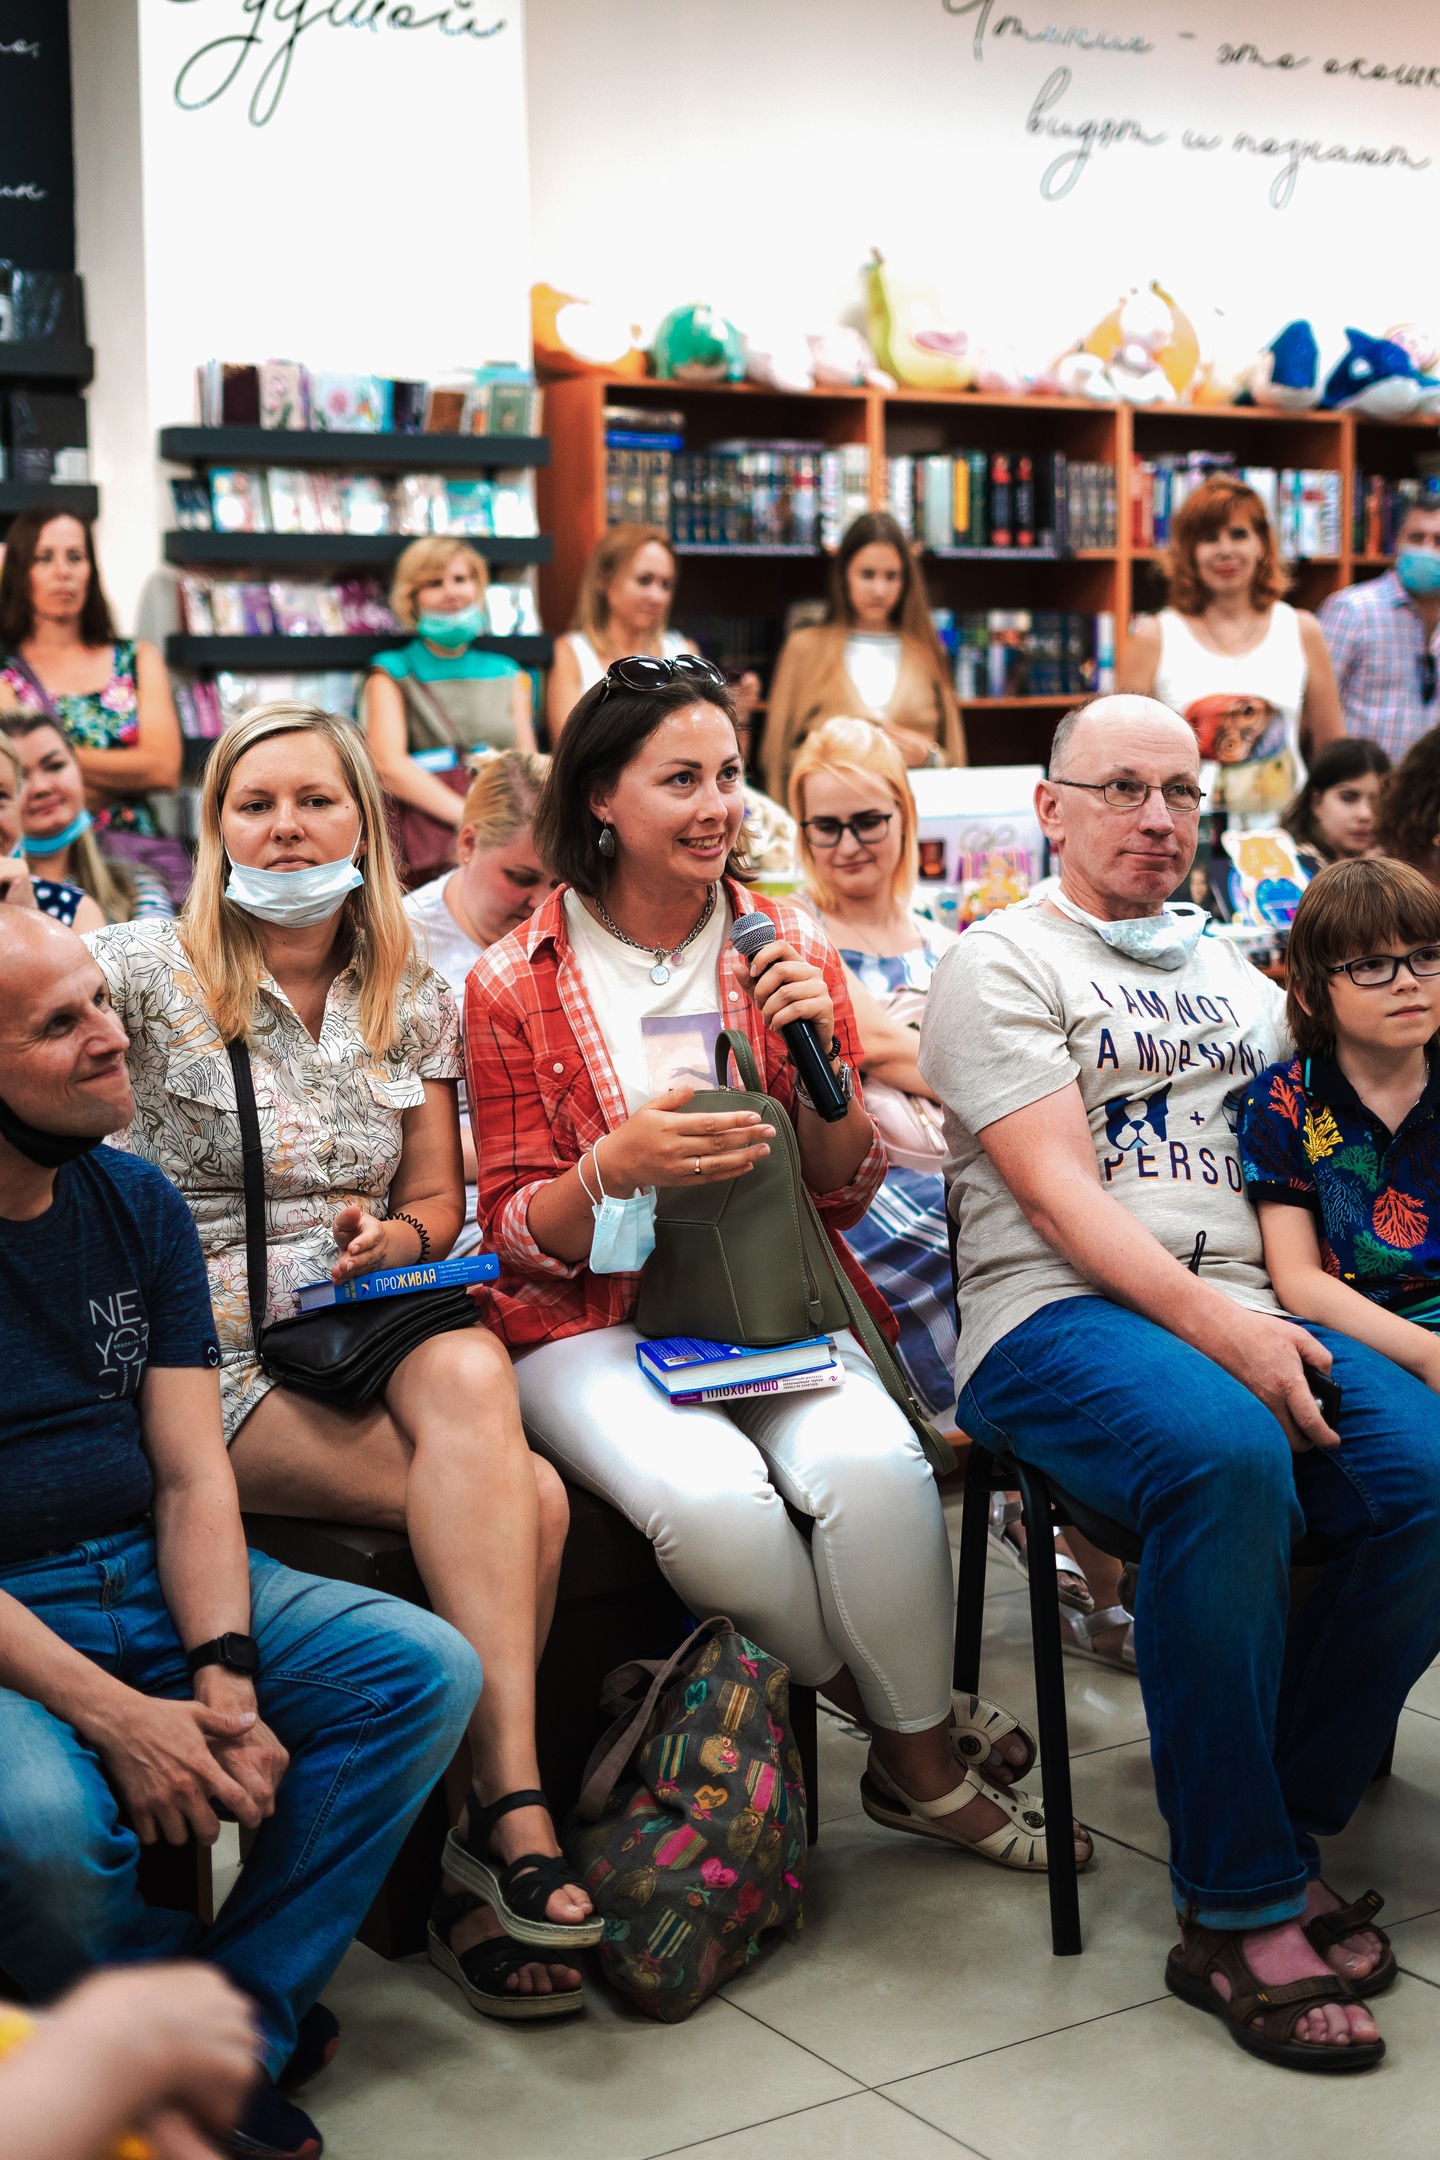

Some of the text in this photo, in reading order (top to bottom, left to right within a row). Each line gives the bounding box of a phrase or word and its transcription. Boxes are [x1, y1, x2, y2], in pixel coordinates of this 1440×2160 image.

[1182, 127, 1222, 151] и
[1118, 984, 1171, 1024] AM
[1174, 990, 1241, 1028] NOT
[1096, 1028, 1120, 1070] A
[375, 1268, 437, 1292] ПРОЖИВАЯ
[707, 1379, 780, 1399] ПЛОХОРОШО
